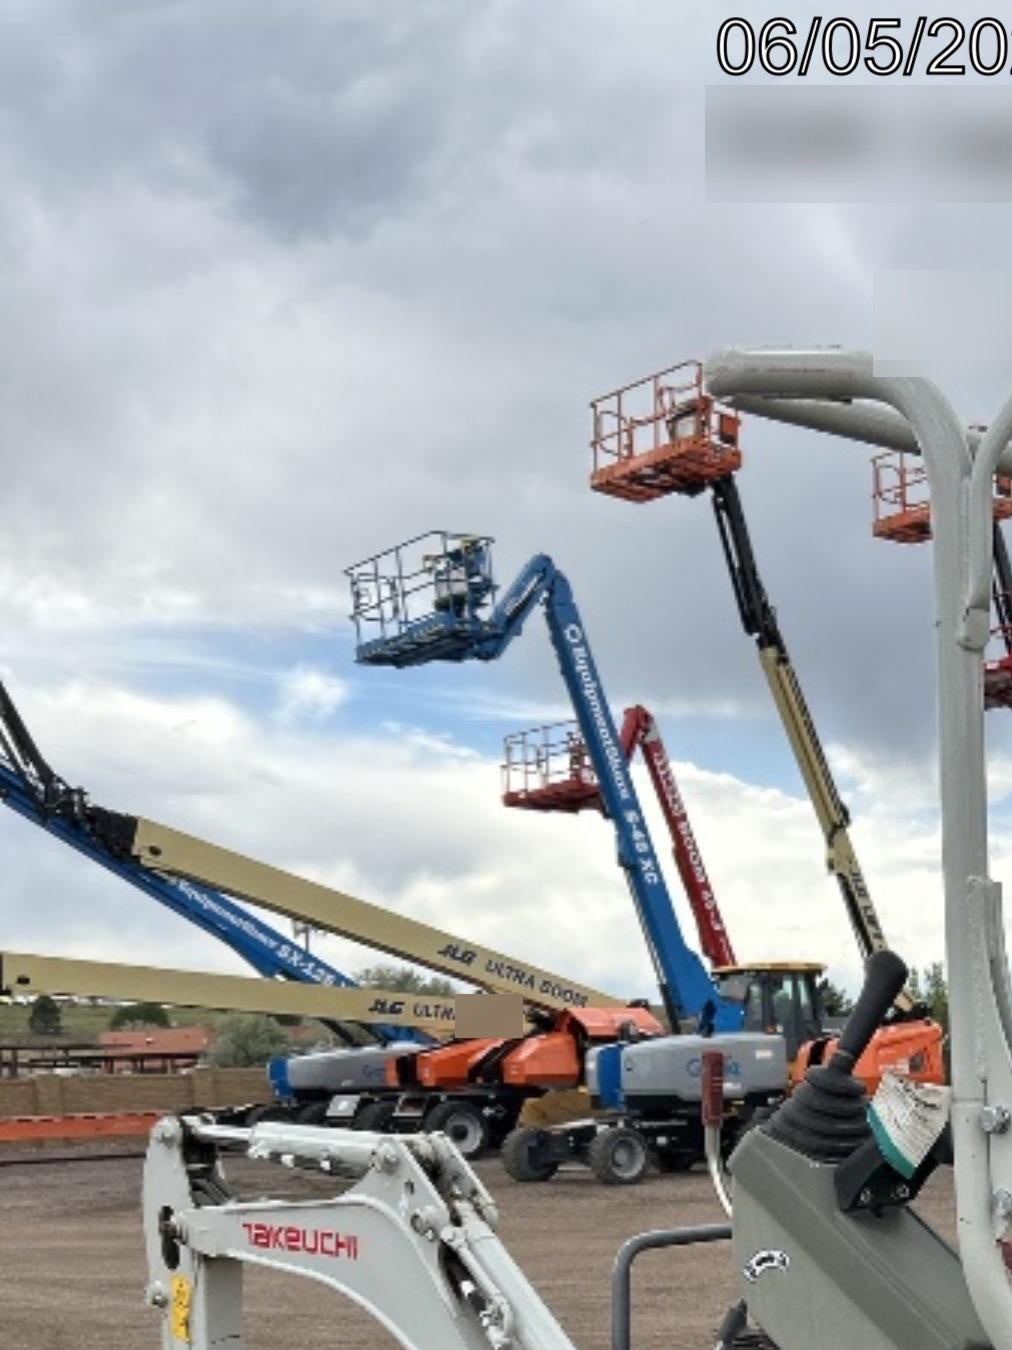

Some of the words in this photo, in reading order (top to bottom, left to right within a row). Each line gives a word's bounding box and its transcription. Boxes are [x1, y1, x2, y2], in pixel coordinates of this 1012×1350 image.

[437, 944, 478, 965] JLG
[485, 959, 536, 989] ULTRA
[539, 980, 589, 1009] BOOM
[367, 998, 405, 1015] JLG
[412, 1002, 455, 1021] ULTR
